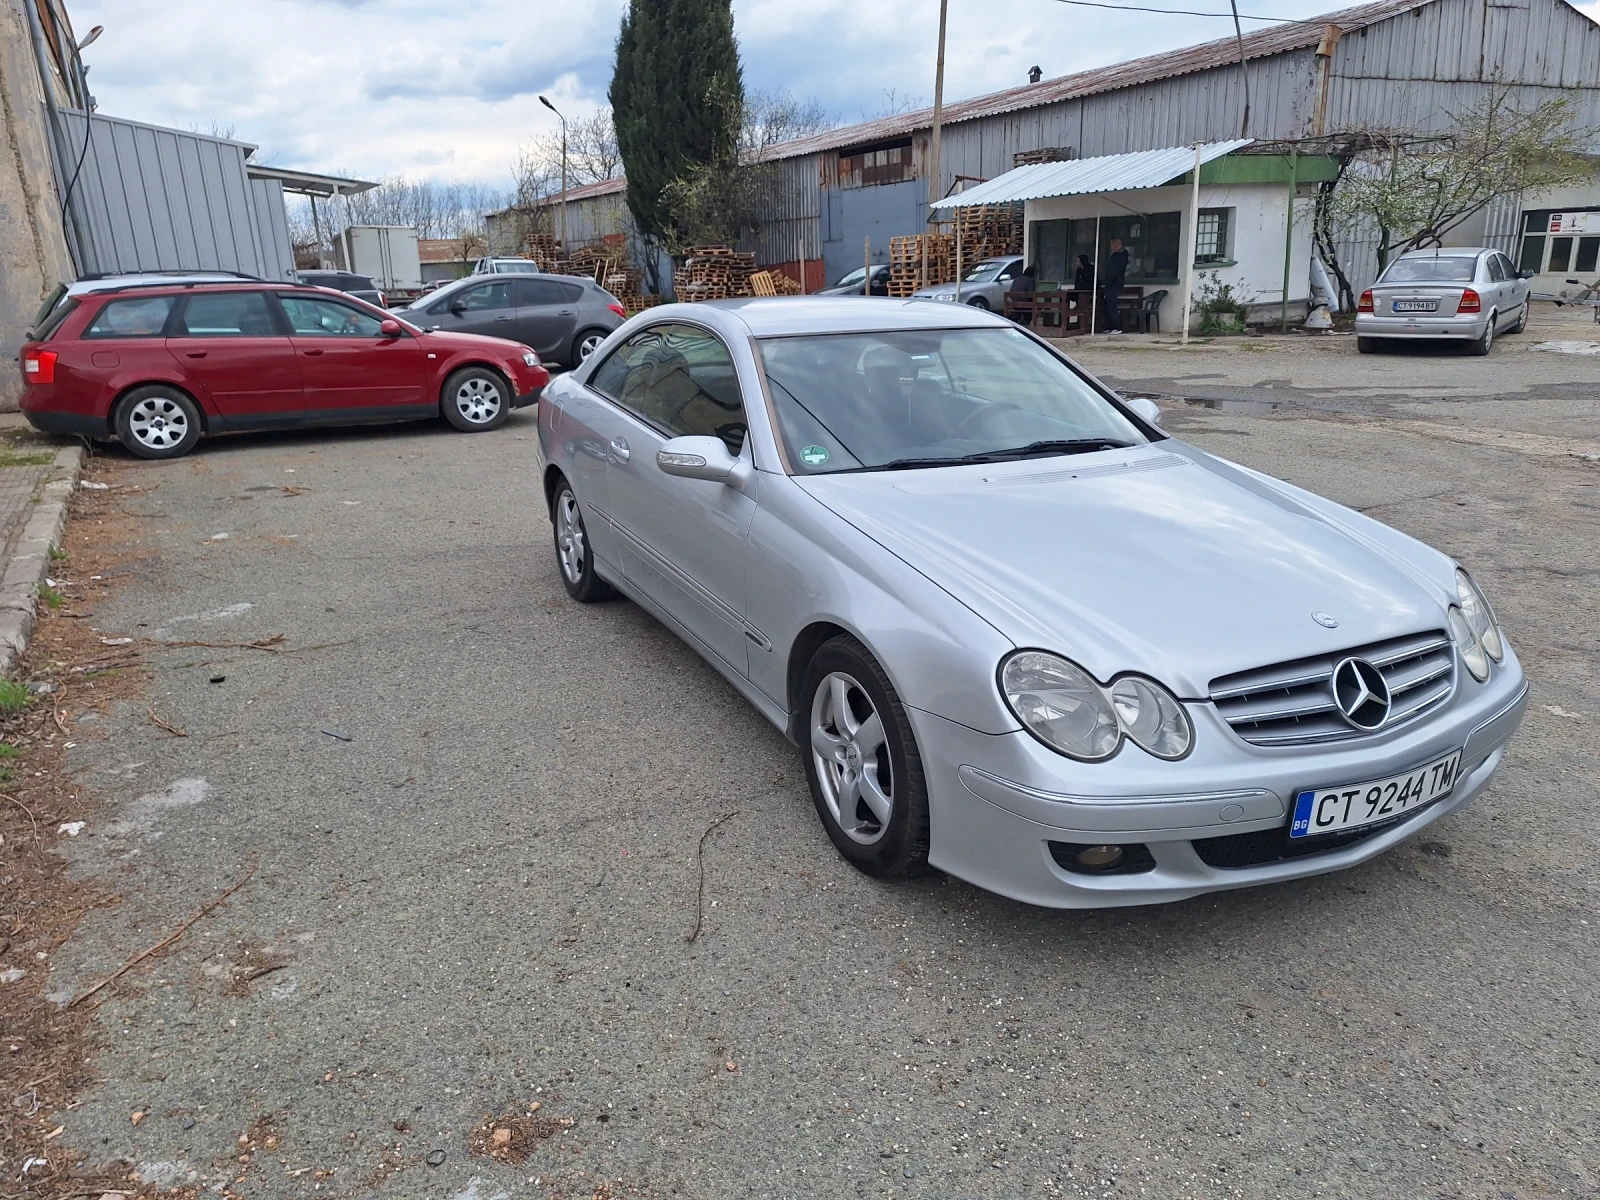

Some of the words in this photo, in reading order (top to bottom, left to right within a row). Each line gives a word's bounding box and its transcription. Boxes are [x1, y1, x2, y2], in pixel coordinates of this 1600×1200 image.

[1399, 302, 1408, 310] CT
[1425, 302, 1435, 310] BT
[1316, 790, 1360, 827] CT
[1365, 771, 1426, 818] 9244
[1430, 757, 1457, 795] TM
[1293, 819, 1308, 831] BG
